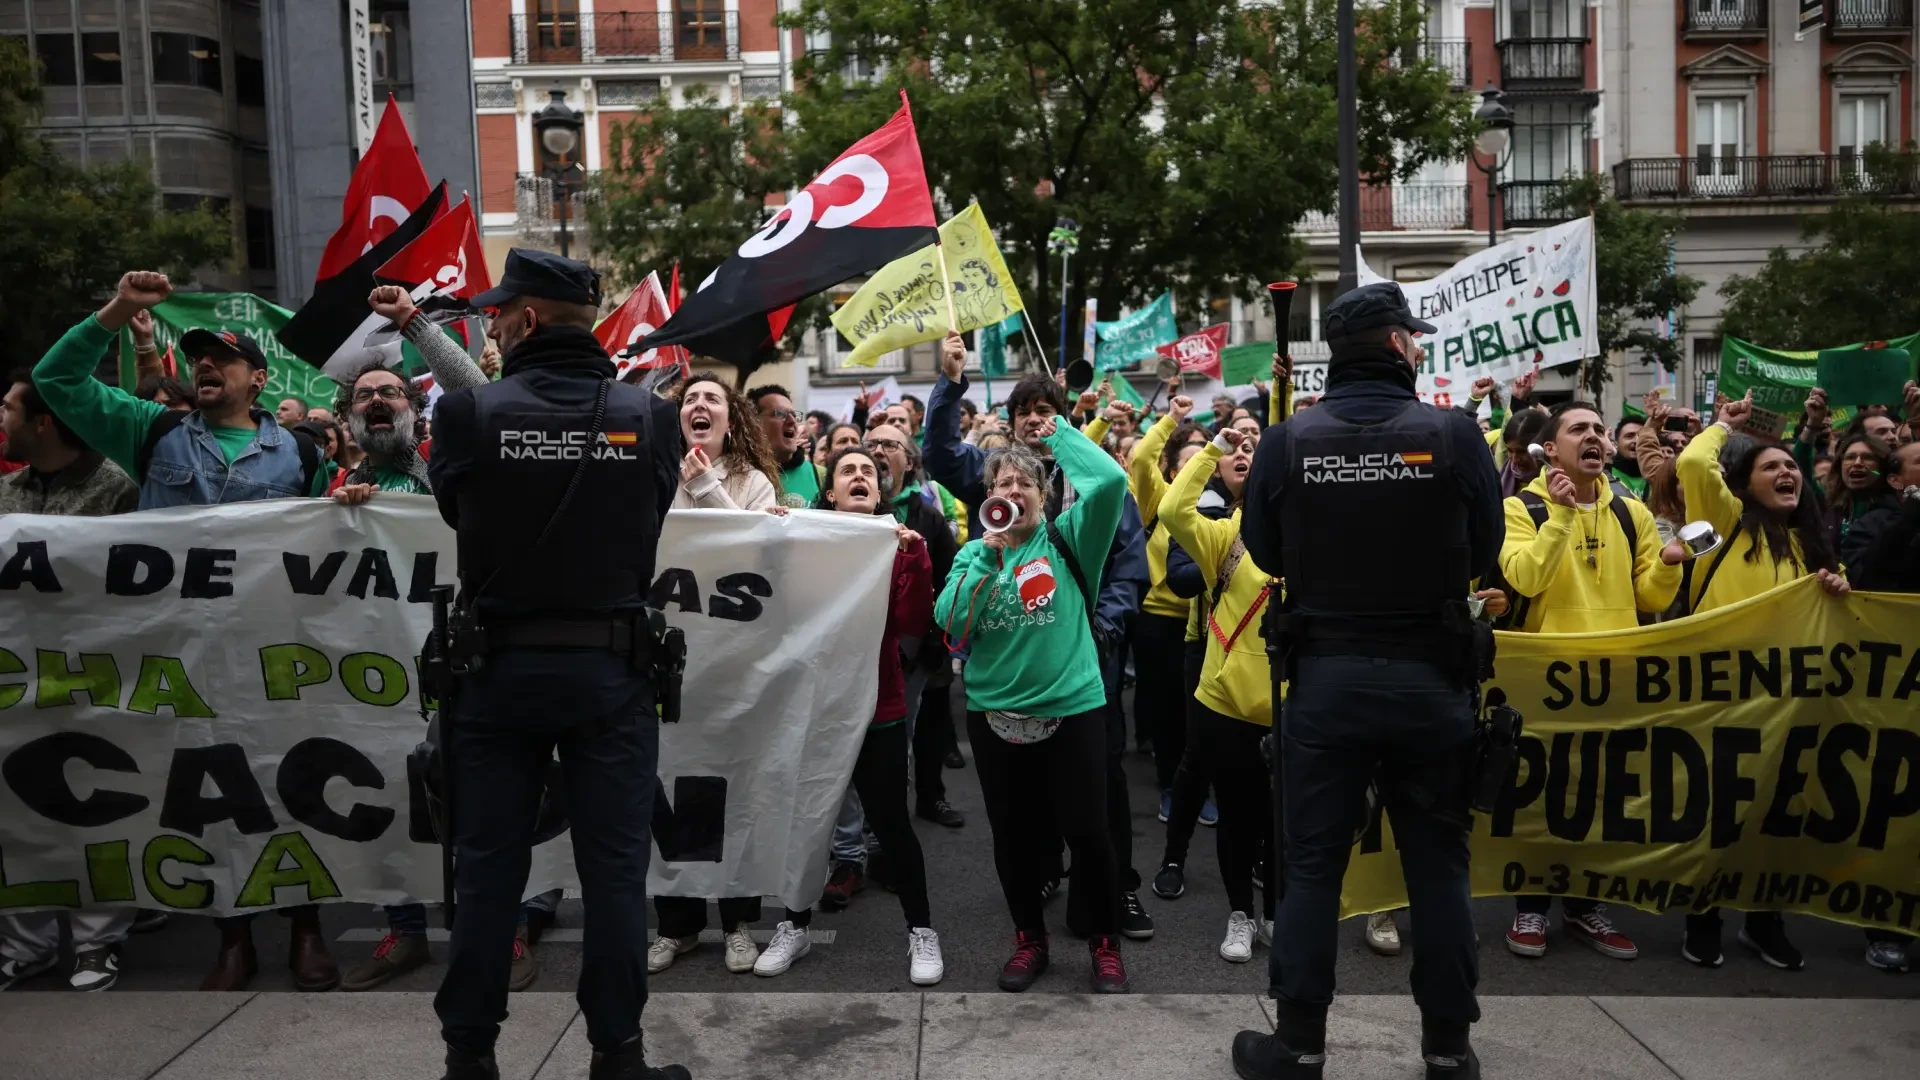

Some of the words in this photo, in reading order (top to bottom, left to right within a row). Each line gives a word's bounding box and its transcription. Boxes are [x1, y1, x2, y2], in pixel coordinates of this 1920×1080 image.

[354, 8, 365, 39] 31
[1453, 256, 1528, 308] FELIPE
[500, 446, 637, 460] NACIONAL
[1303, 452, 1406, 469] POLICIA
[1304, 466, 1434, 484] NACIONAL
[106, 544, 236, 599] DE
[1543, 659, 1612, 711] SU
[1490, 725, 1762, 849] PUEDE
[1502, 861, 1571, 894] 0-3
[1753, 871, 1920, 930] IMPORT
